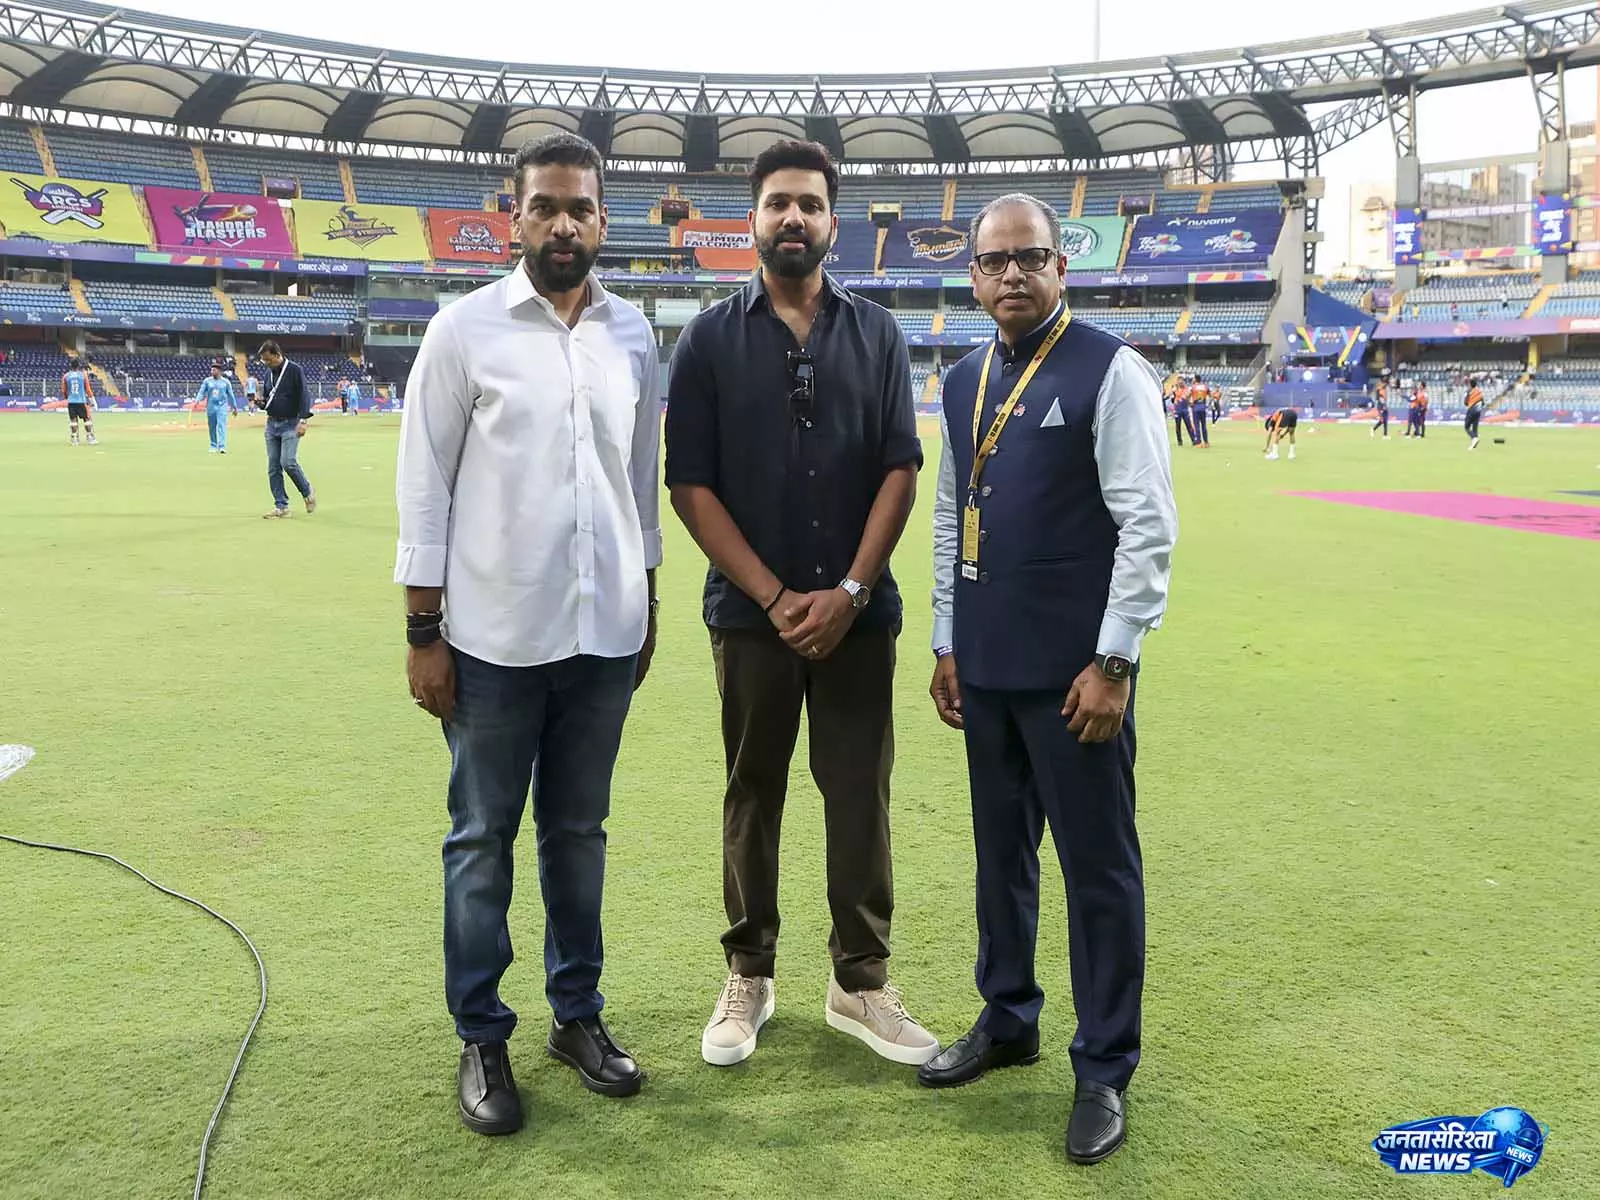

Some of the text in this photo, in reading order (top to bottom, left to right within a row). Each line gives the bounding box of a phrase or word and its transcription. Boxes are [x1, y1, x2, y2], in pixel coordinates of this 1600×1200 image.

[40, 195, 92, 208] ARCS
[1187, 216, 1237, 226] nuvama
[185, 228, 267, 239] BLASTERS
[685, 240, 740, 248] FALCONS
[455, 245, 501, 254] ROYALS
